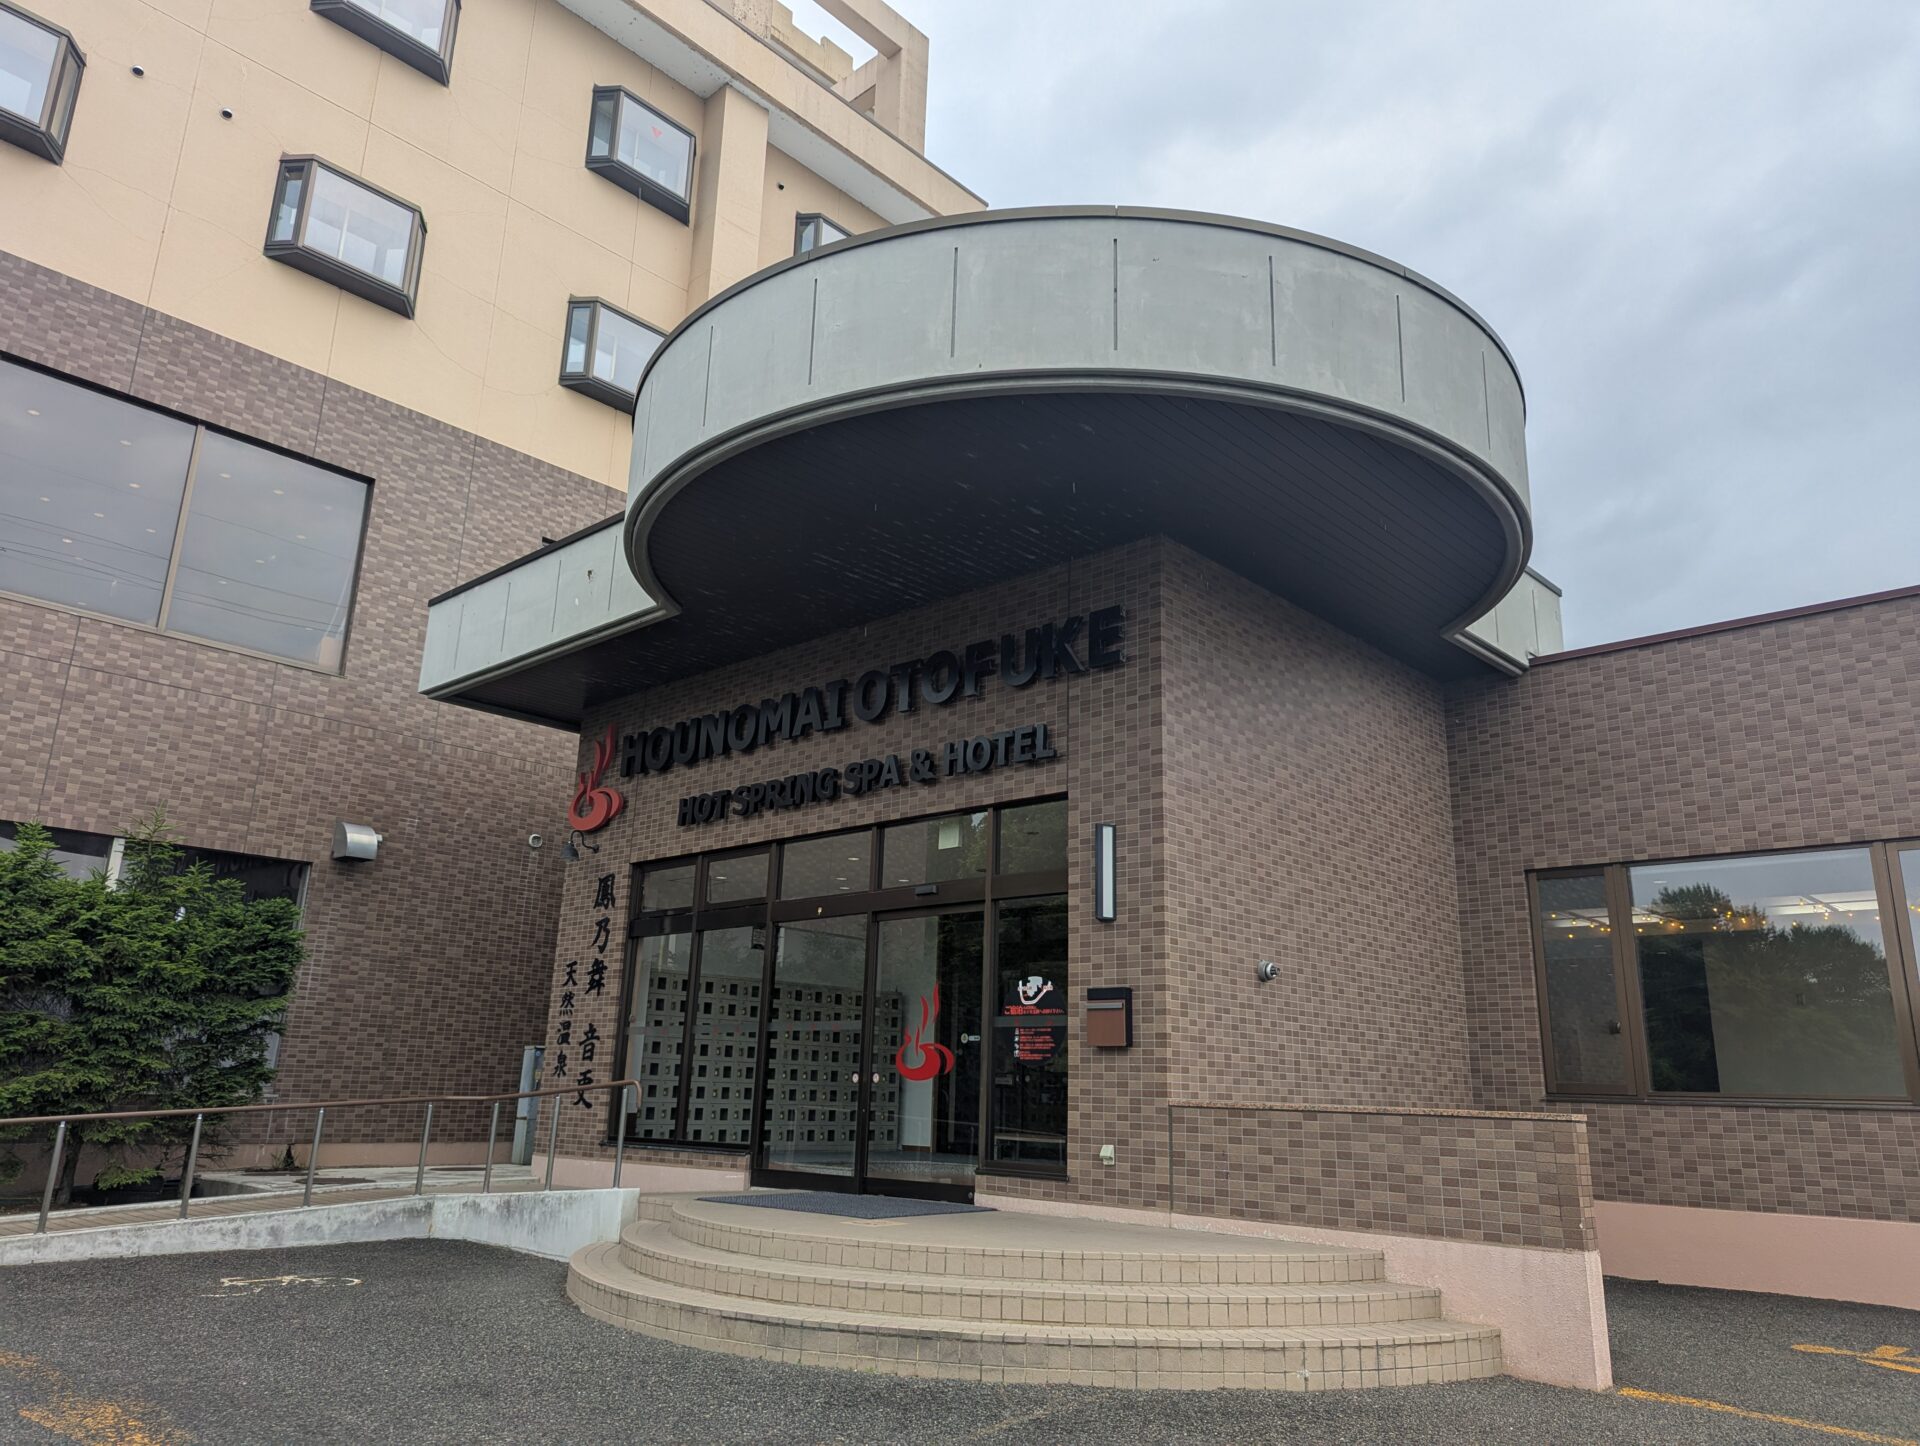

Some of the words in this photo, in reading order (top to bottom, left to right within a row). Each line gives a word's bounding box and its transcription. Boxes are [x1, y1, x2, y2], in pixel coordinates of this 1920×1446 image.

[621, 680, 847, 777] HOUNOMAI
[854, 605, 1127, 722] OTOFUKE
[677, 790, 732, 826] HOT
[732, 768, 840, 816] SPRING
[844, 755, 902, 795] SPA
[911, 749, 937, 783] &
[943, 723, 1056, 776] HOTEL
[553, 961, 578, 1077] 天然温泉
